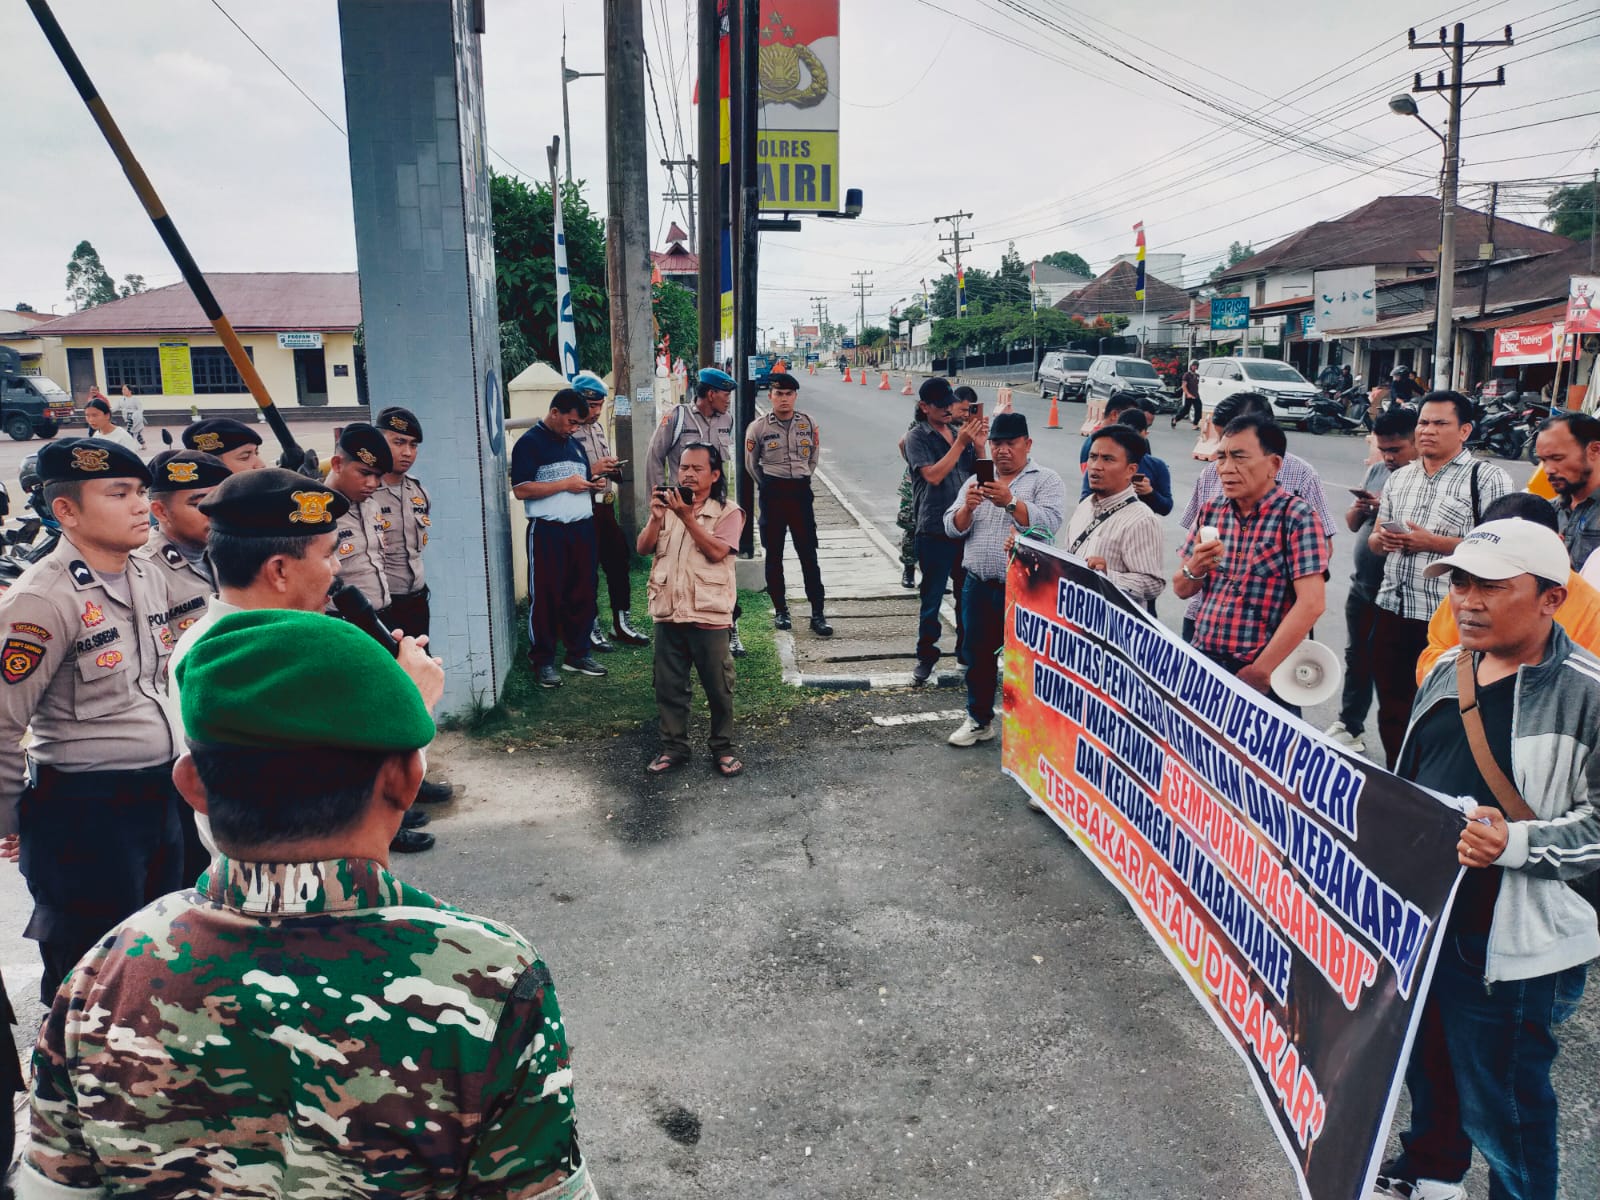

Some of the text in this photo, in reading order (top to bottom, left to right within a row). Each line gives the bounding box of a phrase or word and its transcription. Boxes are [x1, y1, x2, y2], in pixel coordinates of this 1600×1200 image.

[757, 163, 832, 202] AIRI
[758, 139, 811, 158] OLRES
[1213, 300, 1248, 314] KARISA
[1520, 335, 1542, 346] Tobing
[1014, 603, 1049, 655] USUT
[1049, 622, 1102, 688] TUNTAS
[1101, 651, 1167, 741] PENYEBAB
[1165, 703, 1247, 813] KEMATIAN
[1244, 769, 1289, 853] DAN
[1033, 661, 1085, 726] RUMAH
[1085, 690, 1165, 795] WARTAWAN
[1058, 579, 1364, 837] FORUM WARTAWAN DAIRI DESAK POLRI
[1075, 735, 1291, 1005] DAN KELUARGA DI KABANJAHE
[1144, 865, 1201, 962] ATAU
